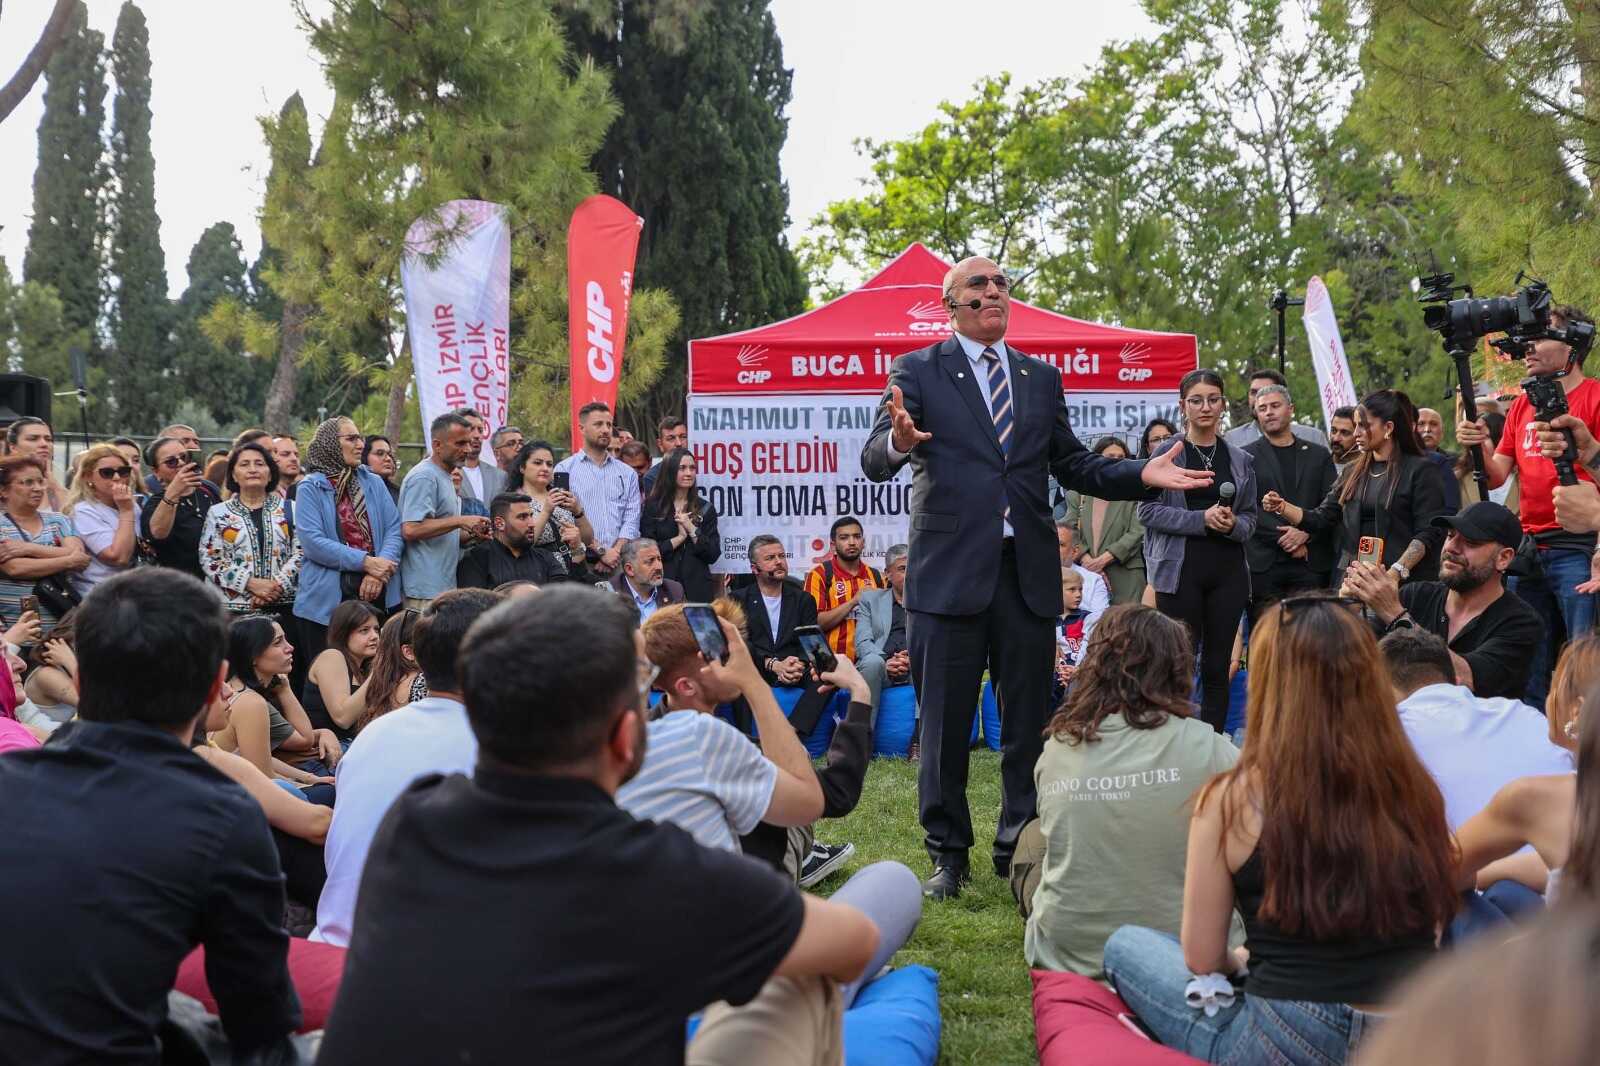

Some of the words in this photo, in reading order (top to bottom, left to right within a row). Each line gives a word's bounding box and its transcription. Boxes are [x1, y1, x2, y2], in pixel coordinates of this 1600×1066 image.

[432, 304, 461, 373] İZMİR
[586, 281, 615, 383] CHP
[909, 321, 953, 331] CH
[494, 328, 506, 426] OLLARI
[737, 370, 772, 384] CHP
[791, 354, 864, 377] BUCA
[1118, 368, 1152, 382] CHP
[692, 406, 815, 431] MAHMUT
[1068, 400, 1107, 428] BİR
[1115, 400, 1146, 431] İŞİ
[693, 442, 743, 480] HOŞ
[751, 436, 838, 474] GELDİN
[751, 485, 827, 516] TOMA
[1086, 767, 1181, 791] COUTURE
[1101, 790, 1130, 801] TOKYO
